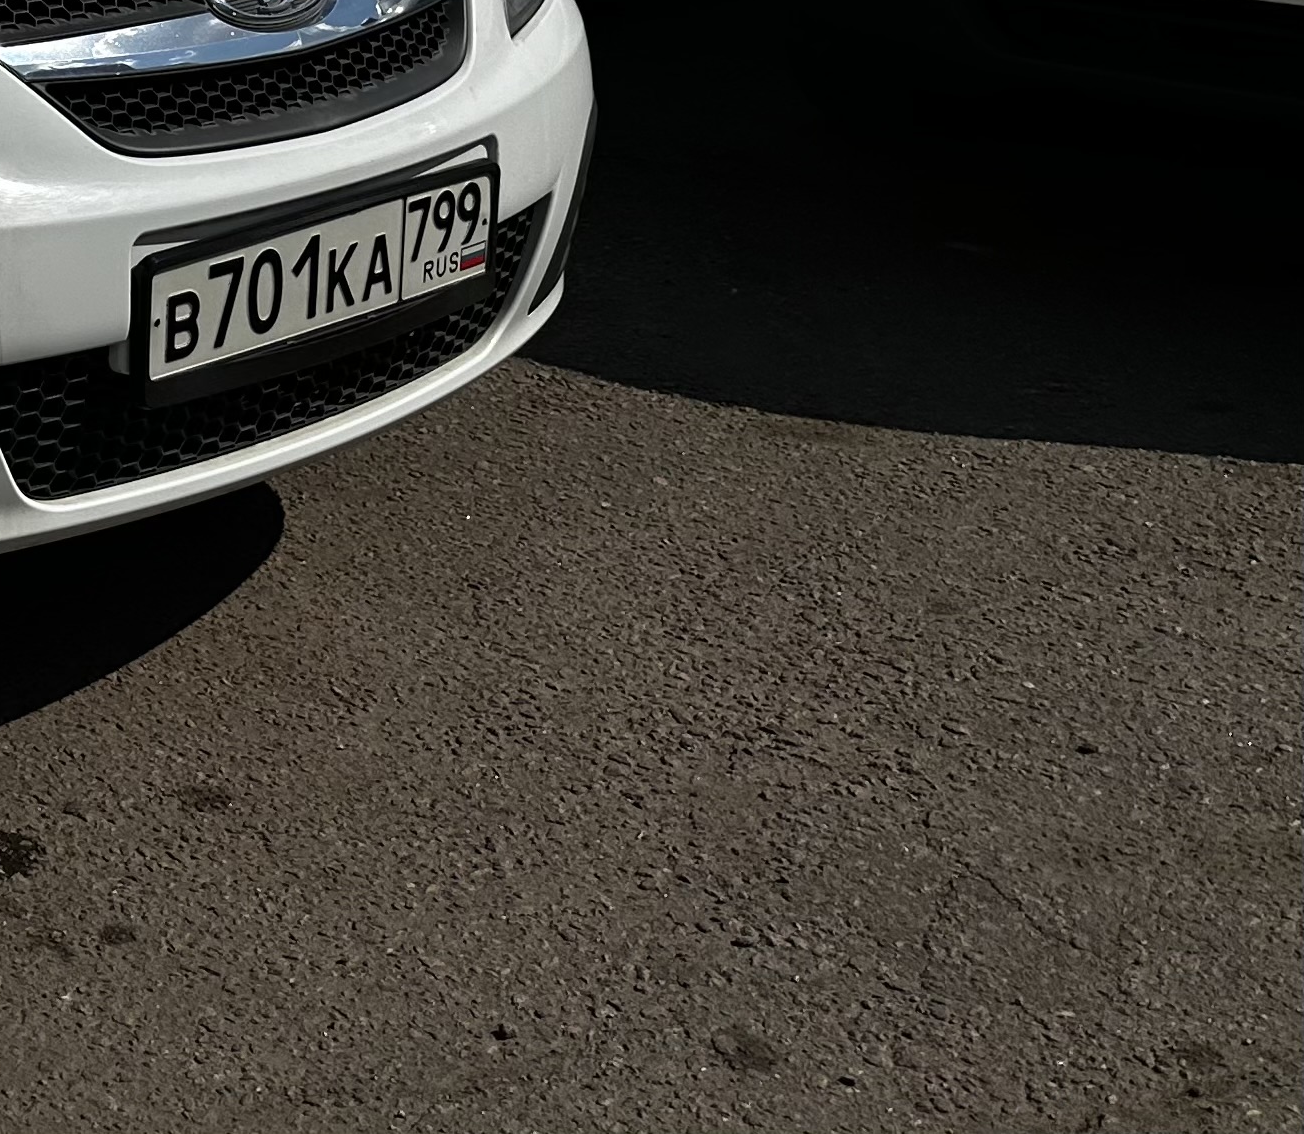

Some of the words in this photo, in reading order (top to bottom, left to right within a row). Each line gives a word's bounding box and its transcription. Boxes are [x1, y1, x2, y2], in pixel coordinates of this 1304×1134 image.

[164, 232, 393, 363] В701КА
[407, 181, 482, 263] 799
[422, 251, 460, 284] RUS
